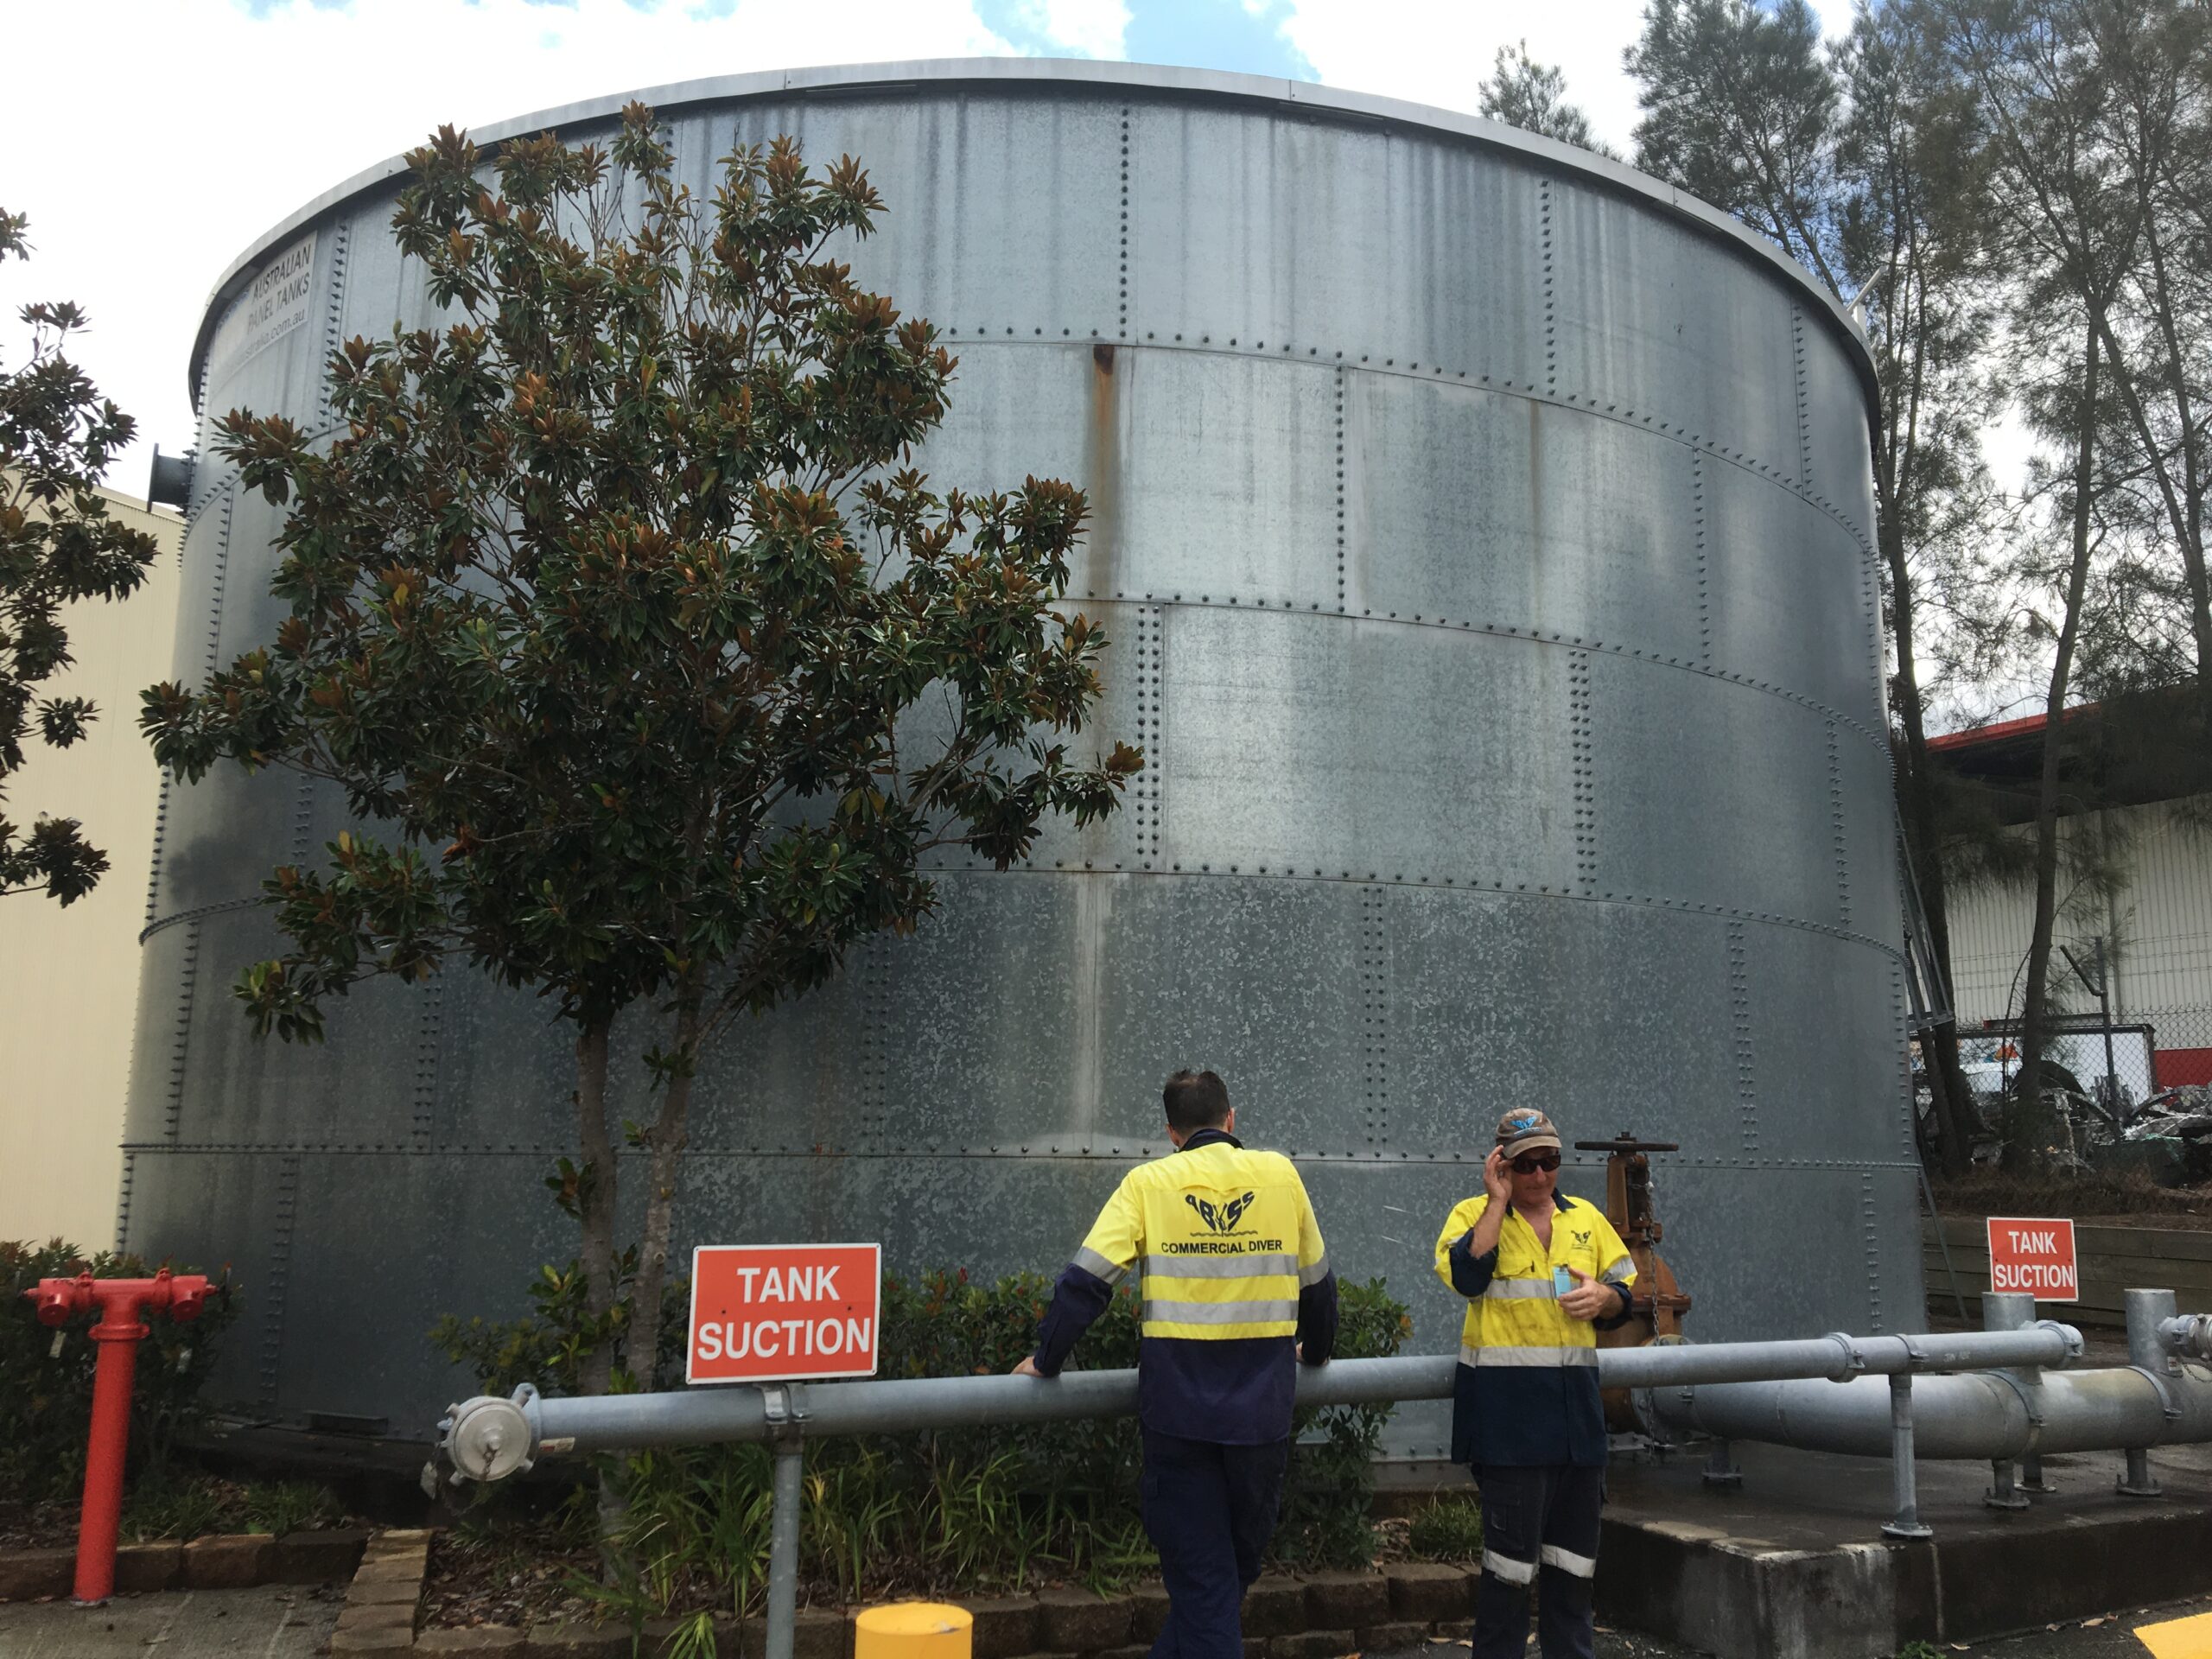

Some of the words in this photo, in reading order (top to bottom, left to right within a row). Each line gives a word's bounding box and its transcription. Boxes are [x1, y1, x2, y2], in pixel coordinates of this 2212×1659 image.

[252, 244, 312, 303] AUSTRALIAN
[247, 297, 274, 335] PANEL
[276, 271, 310, 311] TANKS
[1161, 1241, 1245, 1255] COMMERCIAL
[1249, 1239, 1283, 1252] DIVER
[2008, 1230, 2057, 1254] TANK
[736, 1265, 841, 1304] TANK
[1994, 1264, 2075, 1288] SUCTION
[697, 1317, 871, 1361] SUCTION
